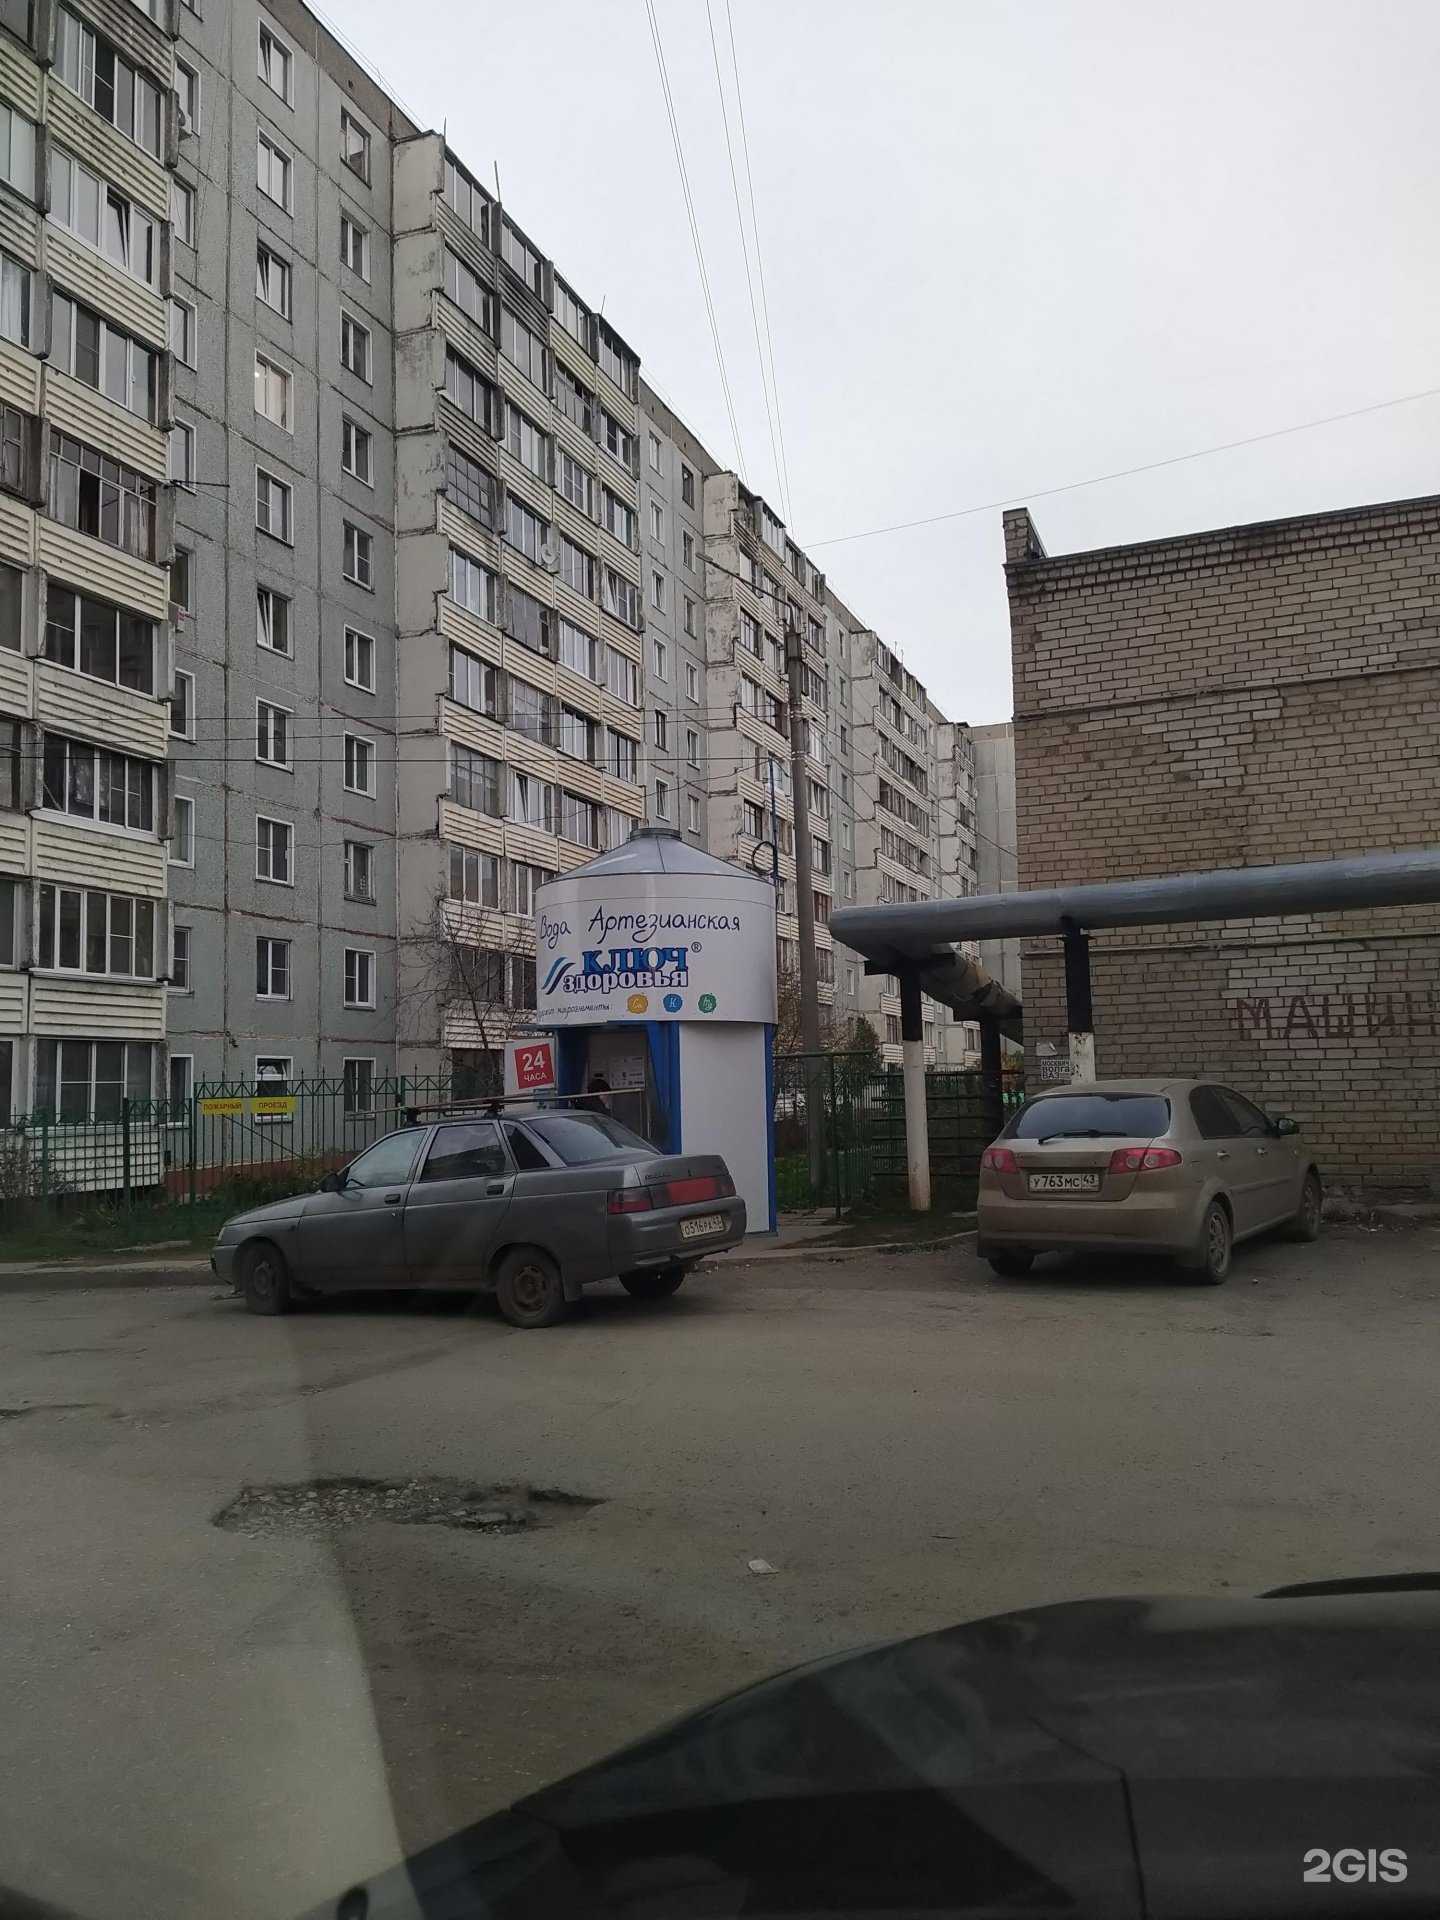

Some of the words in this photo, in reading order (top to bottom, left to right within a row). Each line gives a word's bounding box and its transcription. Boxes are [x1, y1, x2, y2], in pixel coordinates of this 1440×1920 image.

[540, 914, 571, 949] Вода
[588, 905, 740, 945] Артезианская
[522, 1051, 546, 1072] 24
[524, 1072, 548, 1082] ЧАСА
